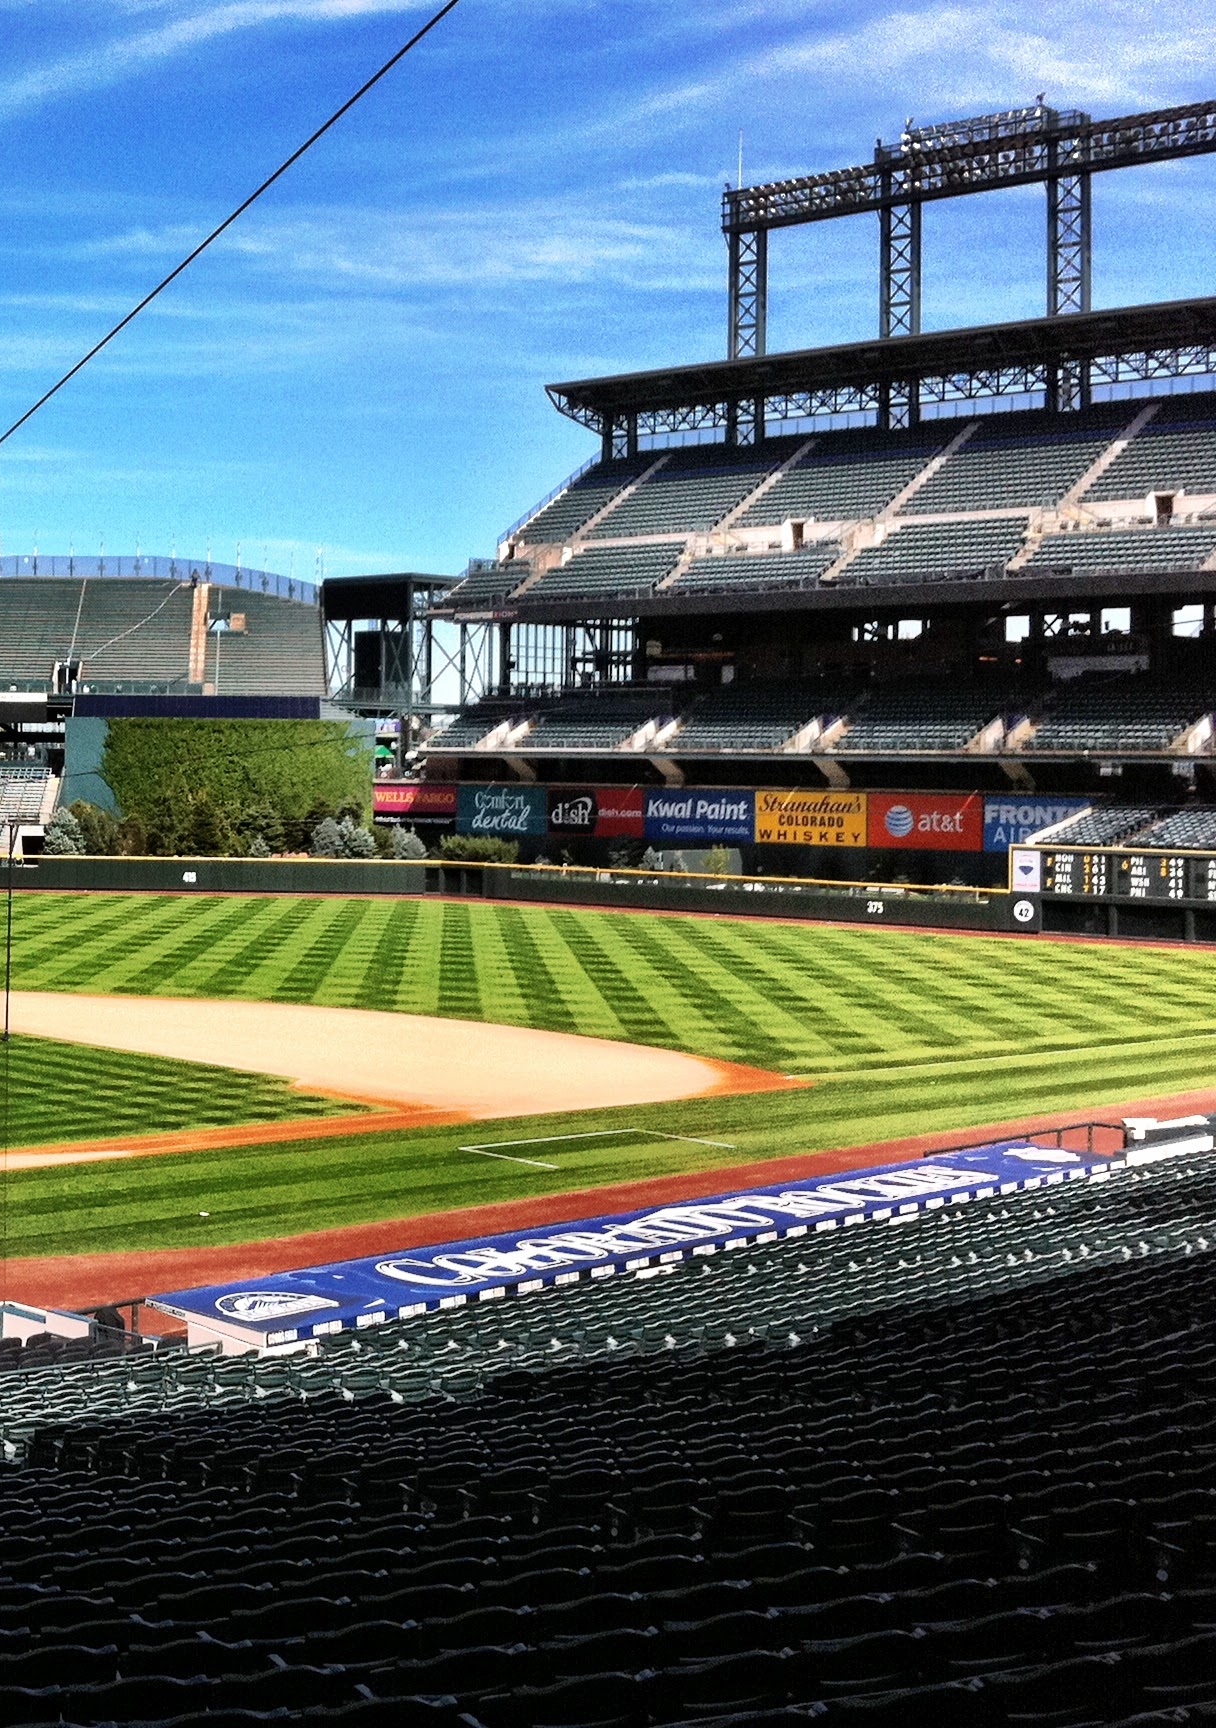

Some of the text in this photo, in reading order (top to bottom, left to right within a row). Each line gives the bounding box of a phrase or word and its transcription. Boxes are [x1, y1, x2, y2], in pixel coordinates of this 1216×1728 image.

[375, 791, 455, 803] WELLS FARGO
[758, 793, 862, 813] Stranahan's
[471, 804, 531, 831] dental
[551, 797, 642, 825] dish dish.com
[646, 797, 748, 820] Kwal Paint
[985, 804, 1078, 825] FRONT
[778, 814, 844, 828] COLORADO
[918, 812, 963, 832] at&t
[758, 828, 861, 842] WHISKEY
[866, 901, 884, 914] 375
[1018, 908, 1030, 918] 42
[375, 1195, 775, 1287] COLORADO
